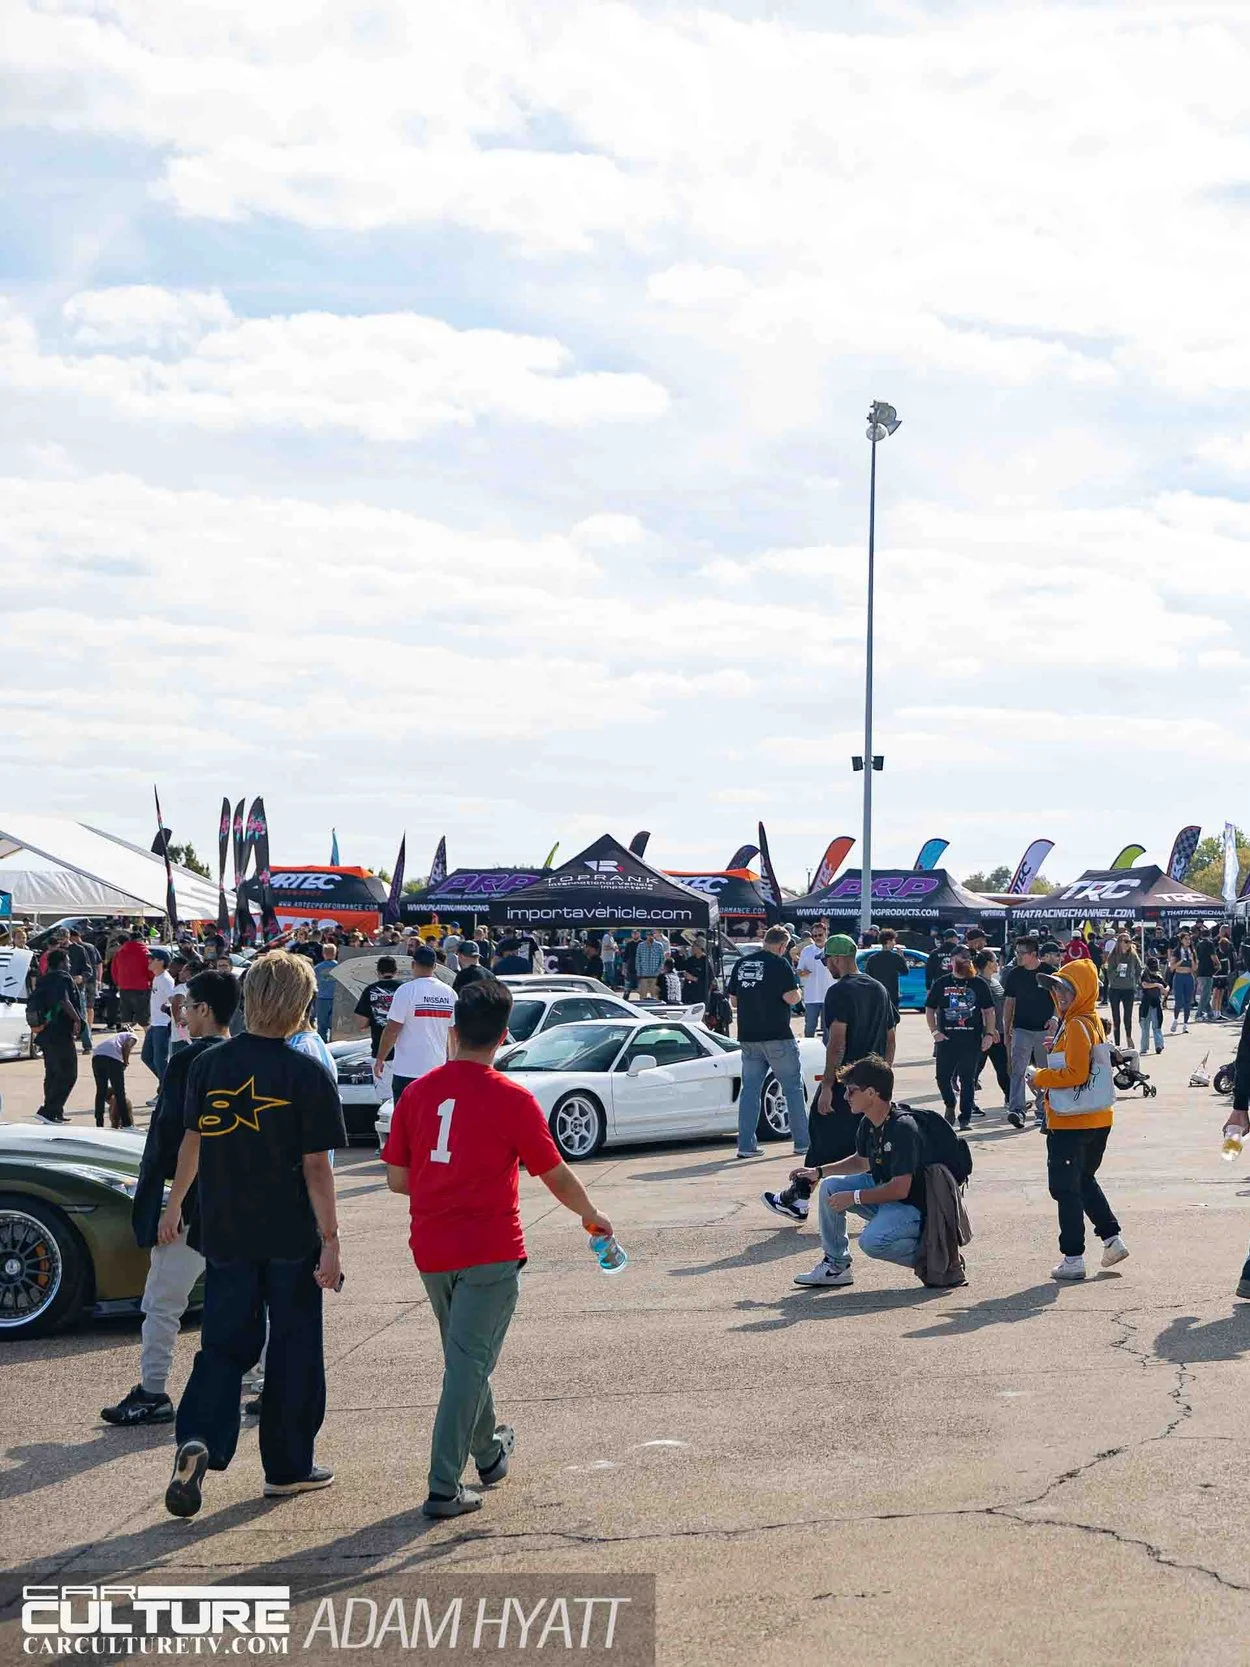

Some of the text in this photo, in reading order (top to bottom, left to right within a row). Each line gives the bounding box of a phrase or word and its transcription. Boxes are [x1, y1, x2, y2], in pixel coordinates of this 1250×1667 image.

[270, 873, 342, 890] ARTEC
[434, 873, 541, 893] PRP
[544, 873, 659, 885] TOPRANK
[827, 877, 939, 898] PRP
[1059, 878, 1141, 902] TRC
[507, 906, 692, 921] importavehicle.com
[796, 908, 939, 918] WWW.PLATINUMRANGPRODUCTS.COM
[1011, 908, 1136, 918] THATRACINGCHANNEL.COM
[1166, 909, 1226, 917] THATRACINGCHAN
[423, 996, 450, 1004] NISSAN
[430, 1098, 457, 1164] 1
